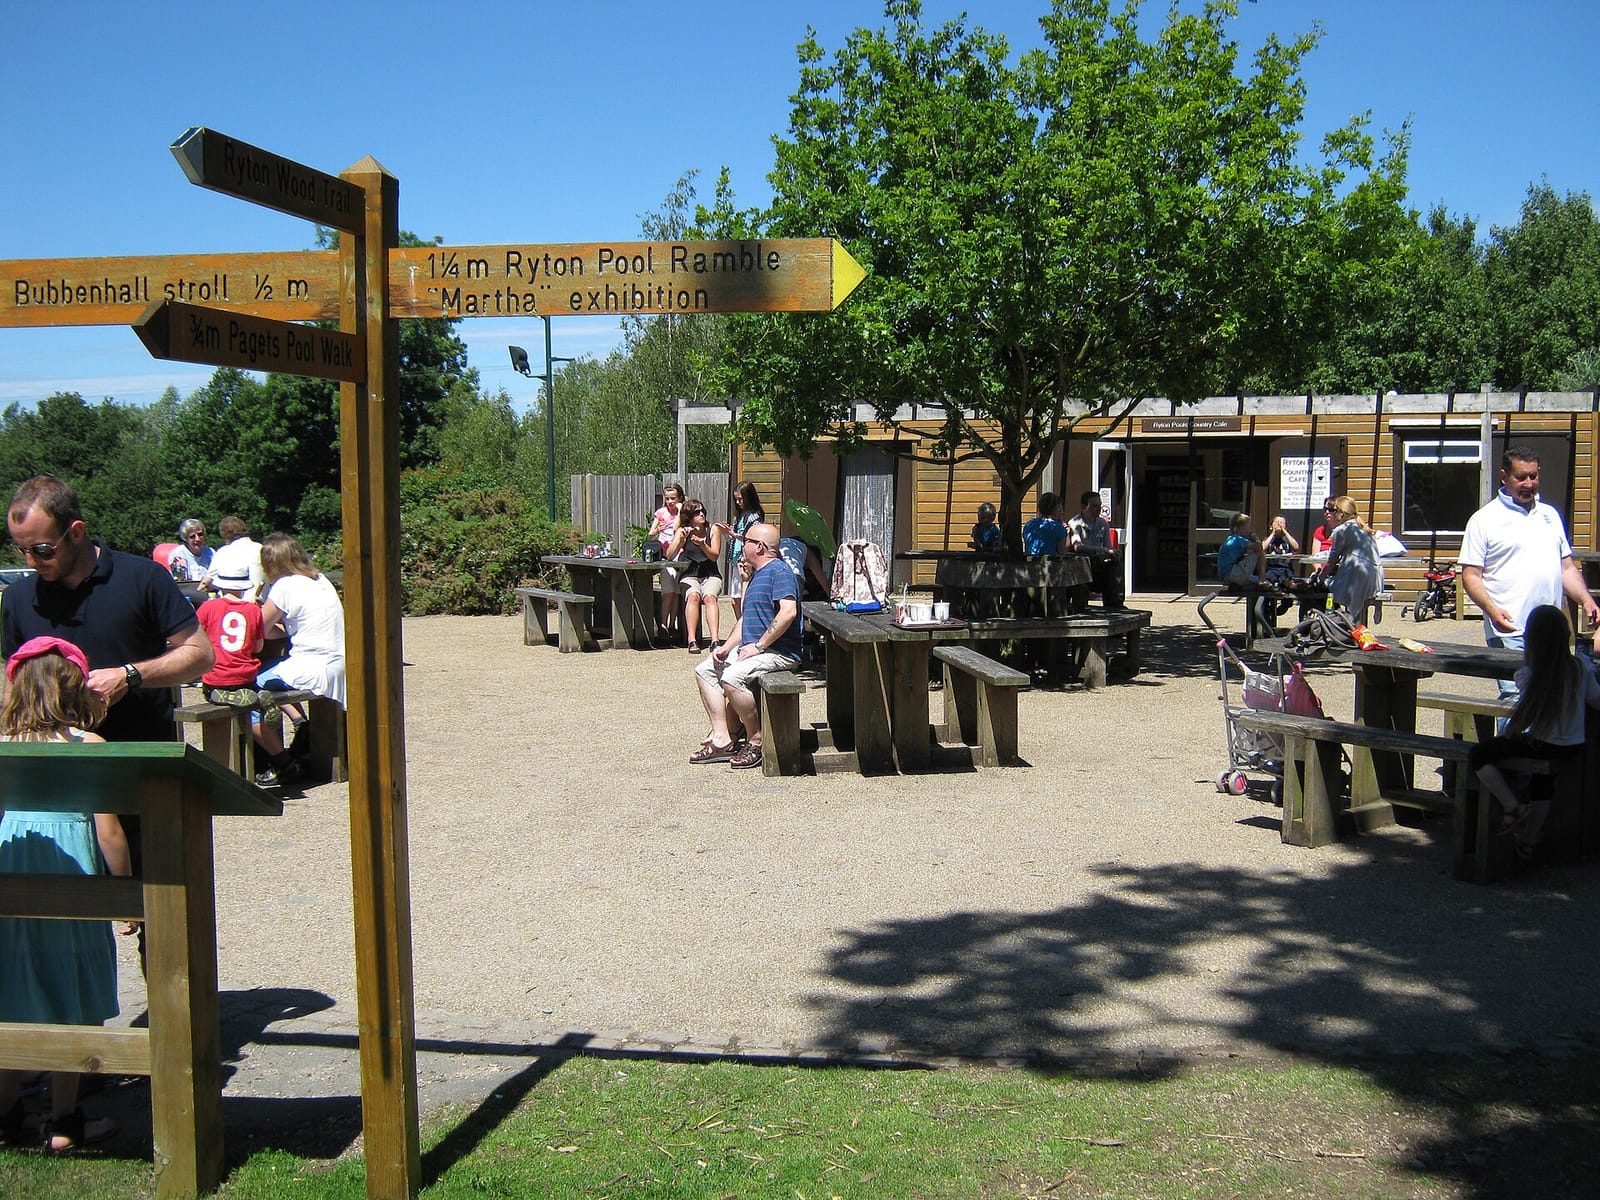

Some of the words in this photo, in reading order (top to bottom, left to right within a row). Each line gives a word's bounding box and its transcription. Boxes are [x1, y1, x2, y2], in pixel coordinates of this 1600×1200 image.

[223, 141, 270, 186] Ryton
[276, 161, 316, 204] Wood
[322, 178, 352, 216] Trail
[506, 250, 584, 285] Ryton
[598, 246, 655, 276] Pool
[671, 243, 781, 274] Ramble
[15, 275, 150, 306] Bubbenhall
[163, 273, 229, 301] stroll
[287, 279, 309, 300] m
[569, 281, 709, 312] exhibition
[229, 319, 280, 363] Pagets
[287, 329, 314, 363] Pool
[320, 335, 352, 368] Walk
[220, 611, 247, 653] 9
